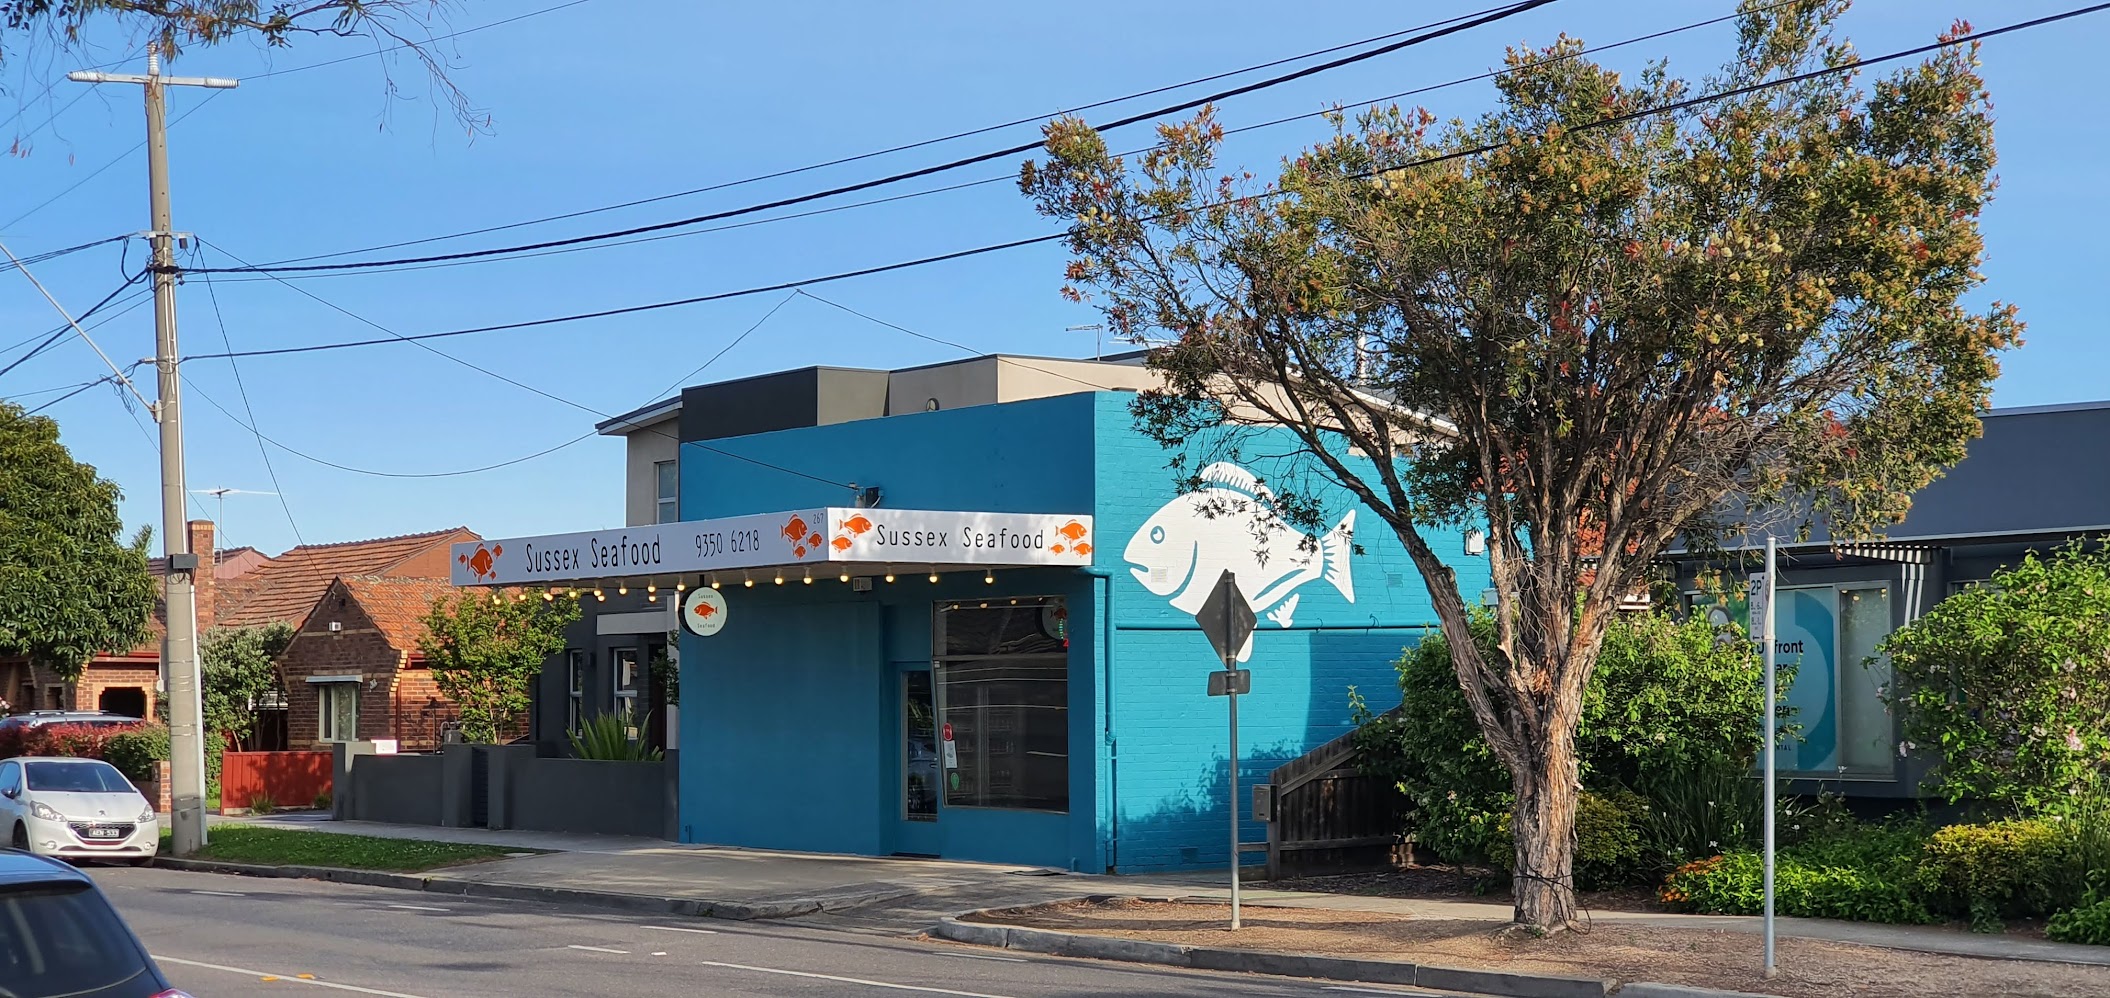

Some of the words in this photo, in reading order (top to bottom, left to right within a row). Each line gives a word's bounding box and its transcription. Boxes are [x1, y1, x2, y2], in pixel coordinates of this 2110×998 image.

[813, 512, 824, 525] 267
[695, 532, 723, 558] 9350
[731, 529, 760, 553] 6218
[876, 524, 948, 547] Sussex
[962, 526, 1044, 549] Seafood
[526, 543, 579, 573] Sussex
[591, 533, 661, 569] Seafood
[1750, 579, 1763, 596] 2P
[1756, 639, 1804, 655] Ufront
